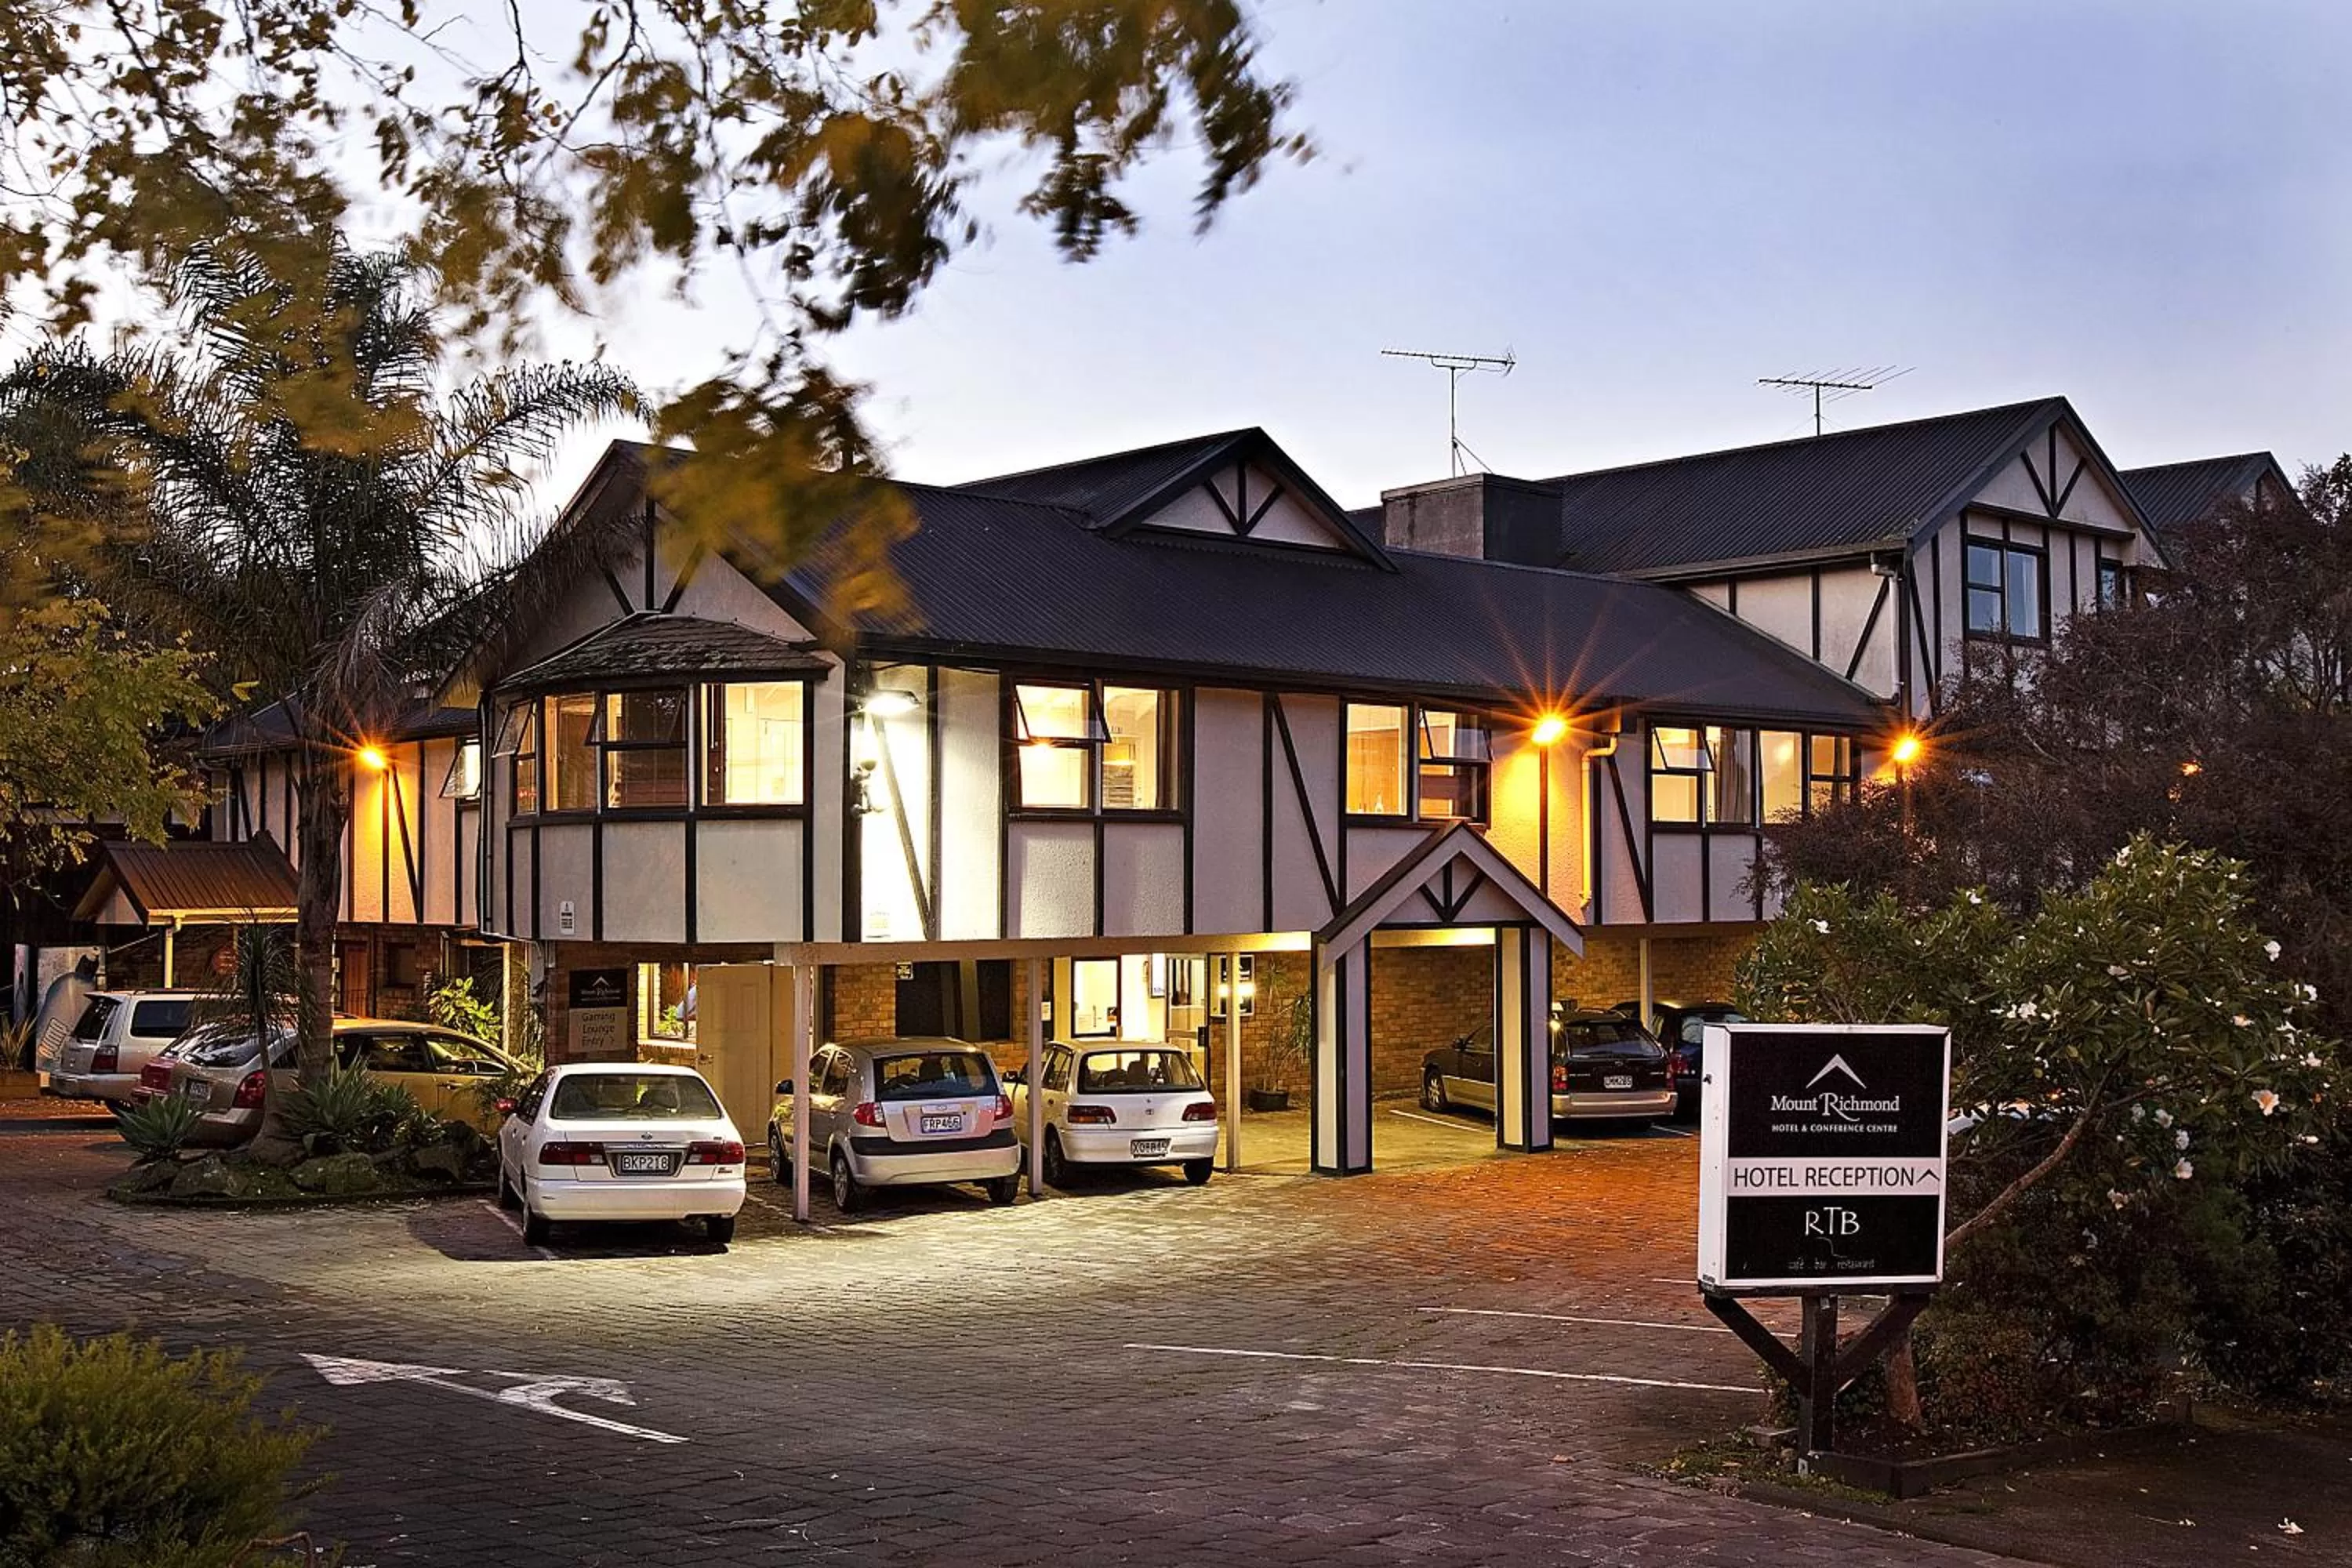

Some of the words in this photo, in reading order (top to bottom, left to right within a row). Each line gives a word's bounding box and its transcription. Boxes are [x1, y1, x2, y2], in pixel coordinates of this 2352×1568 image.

[583, 1024, 615, 1036] Lounge
[1770, 1095, 1817, 1111] Mount
[1818, 1092, 1900, 1122] Richmond
[1771, 1123, 1799, 1133] HOTEL
[1801, 1123, 1808, 1133] &
[1809, 1123, 1865, 1133] CONFERENCE
[1866, 1123, 1898, 1133] CENTRE
[1733, 1167, 1799, 1188] HOTEL
[1804, 1167, 1915, 1187] RECEPTION
[1805, 1207, 1861, 1236] RTB
